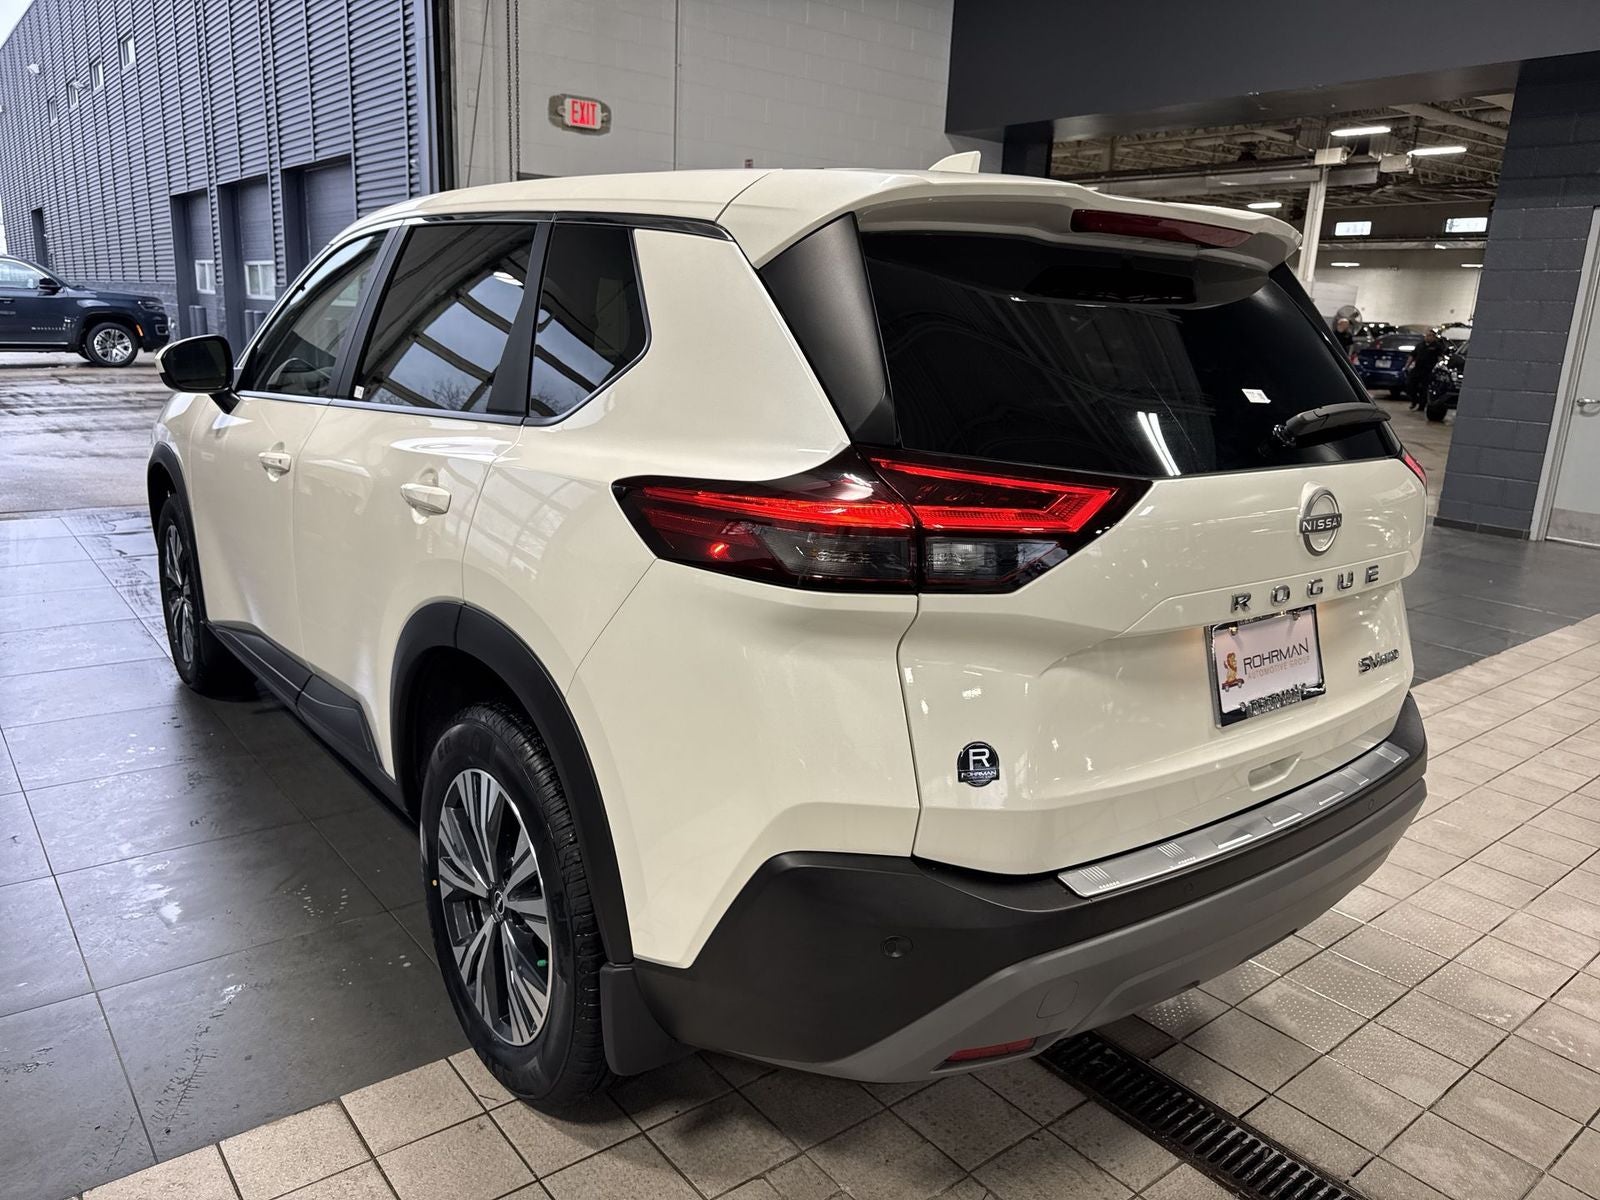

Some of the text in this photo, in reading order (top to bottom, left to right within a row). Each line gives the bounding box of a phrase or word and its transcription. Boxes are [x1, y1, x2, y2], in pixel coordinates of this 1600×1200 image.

[571, 100, 598, 126] EXIT
[1230, 565, 1379, 614] ROGUE
[1243, 637, 1309, 675] ROHRMAN
[969, 748, 990, 770] R
